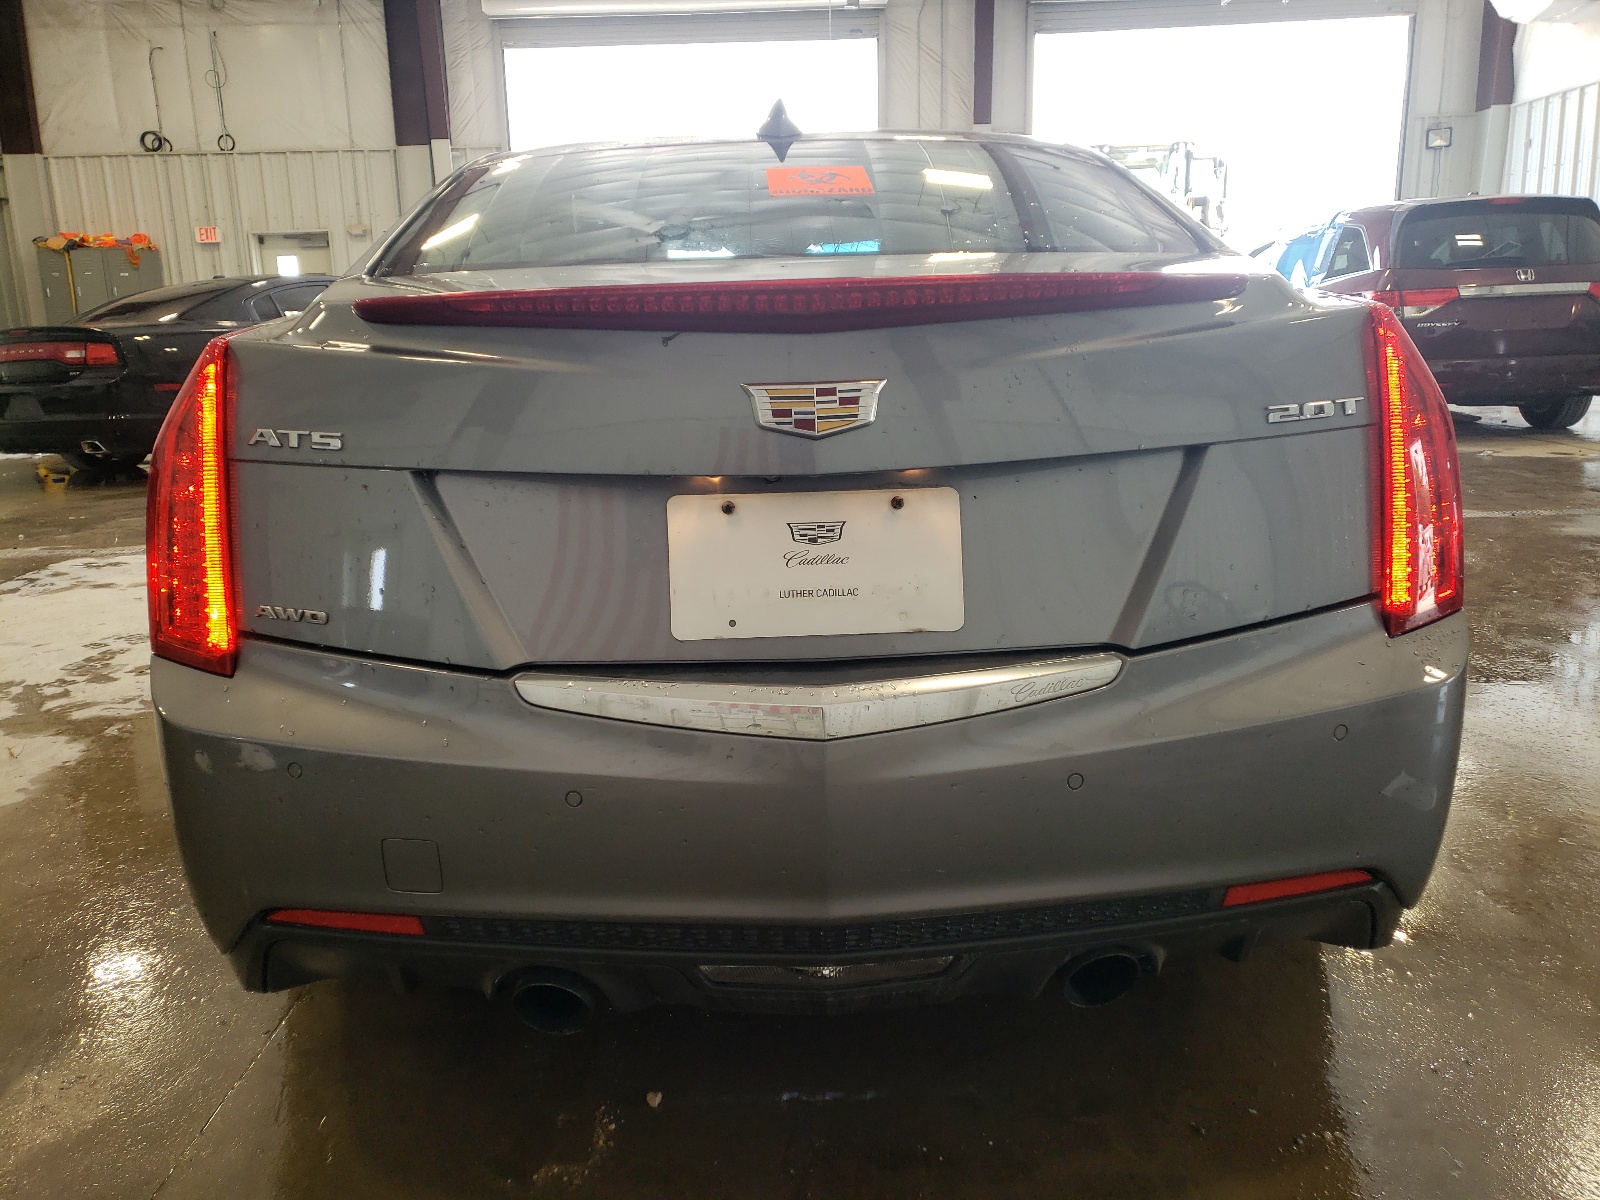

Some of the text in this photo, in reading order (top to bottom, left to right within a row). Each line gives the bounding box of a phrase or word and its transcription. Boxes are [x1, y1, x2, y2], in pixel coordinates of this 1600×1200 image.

[198, 226, 217, 242] EXIT
[247, 428, 344, 451] ATS
[783, 549, 850, 569] Cadillac
[779, 587, 859, 599] LUTHER CADILLAC
[254, 604, 329, 625] AWD
[1010, 678, 1085, 703] Cadillac
